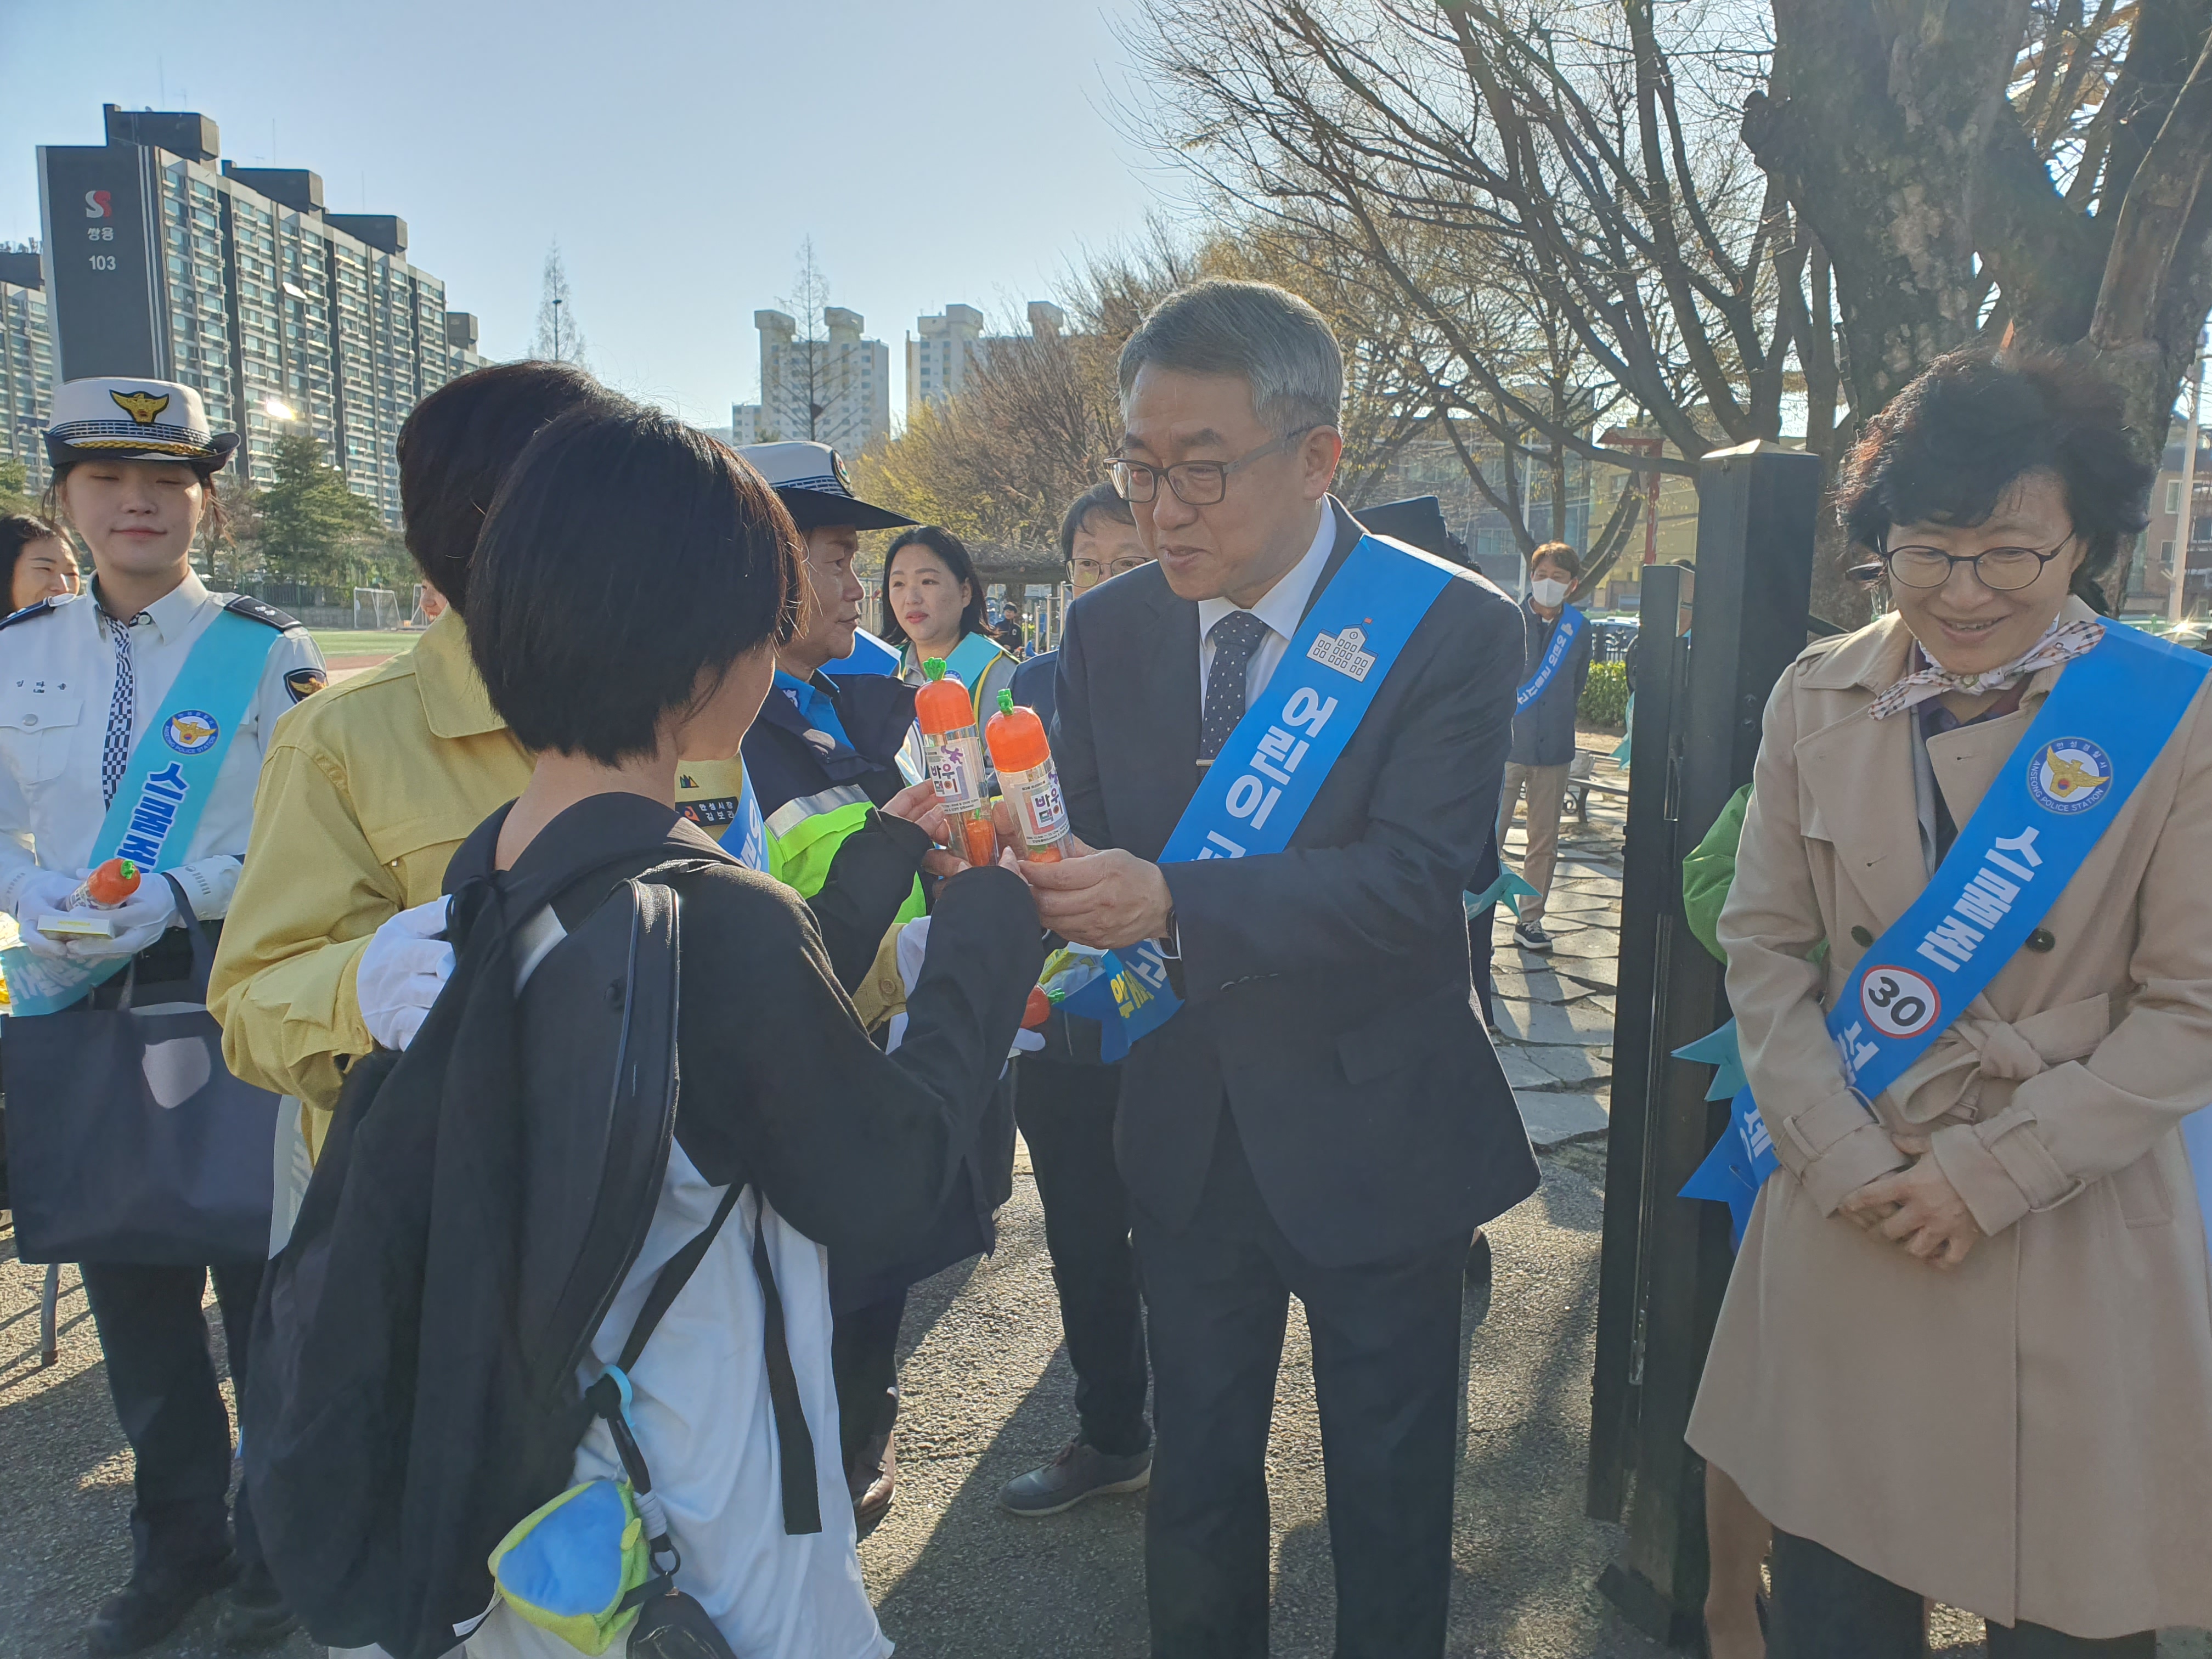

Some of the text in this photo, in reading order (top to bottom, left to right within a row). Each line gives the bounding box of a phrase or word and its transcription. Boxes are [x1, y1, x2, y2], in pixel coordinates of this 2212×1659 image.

[87, 227, 114, 241] 쌍용
[89, 255, 116, 270] 103
[1226, 687, 1339, 830] 어린이
[930, 764, 955, 779] 바우
[934, 778, 958, 795] 덕이
[2030, 760, 2104, 811] ANSEONG POLICE STATION
[1035, 788, 1059, 808] 바우
[1039, 801, 1063, 823] 덕이
[1916, 826, 2043, 973] 스쿨존
[1867, 976, 1926, 1026] 30
